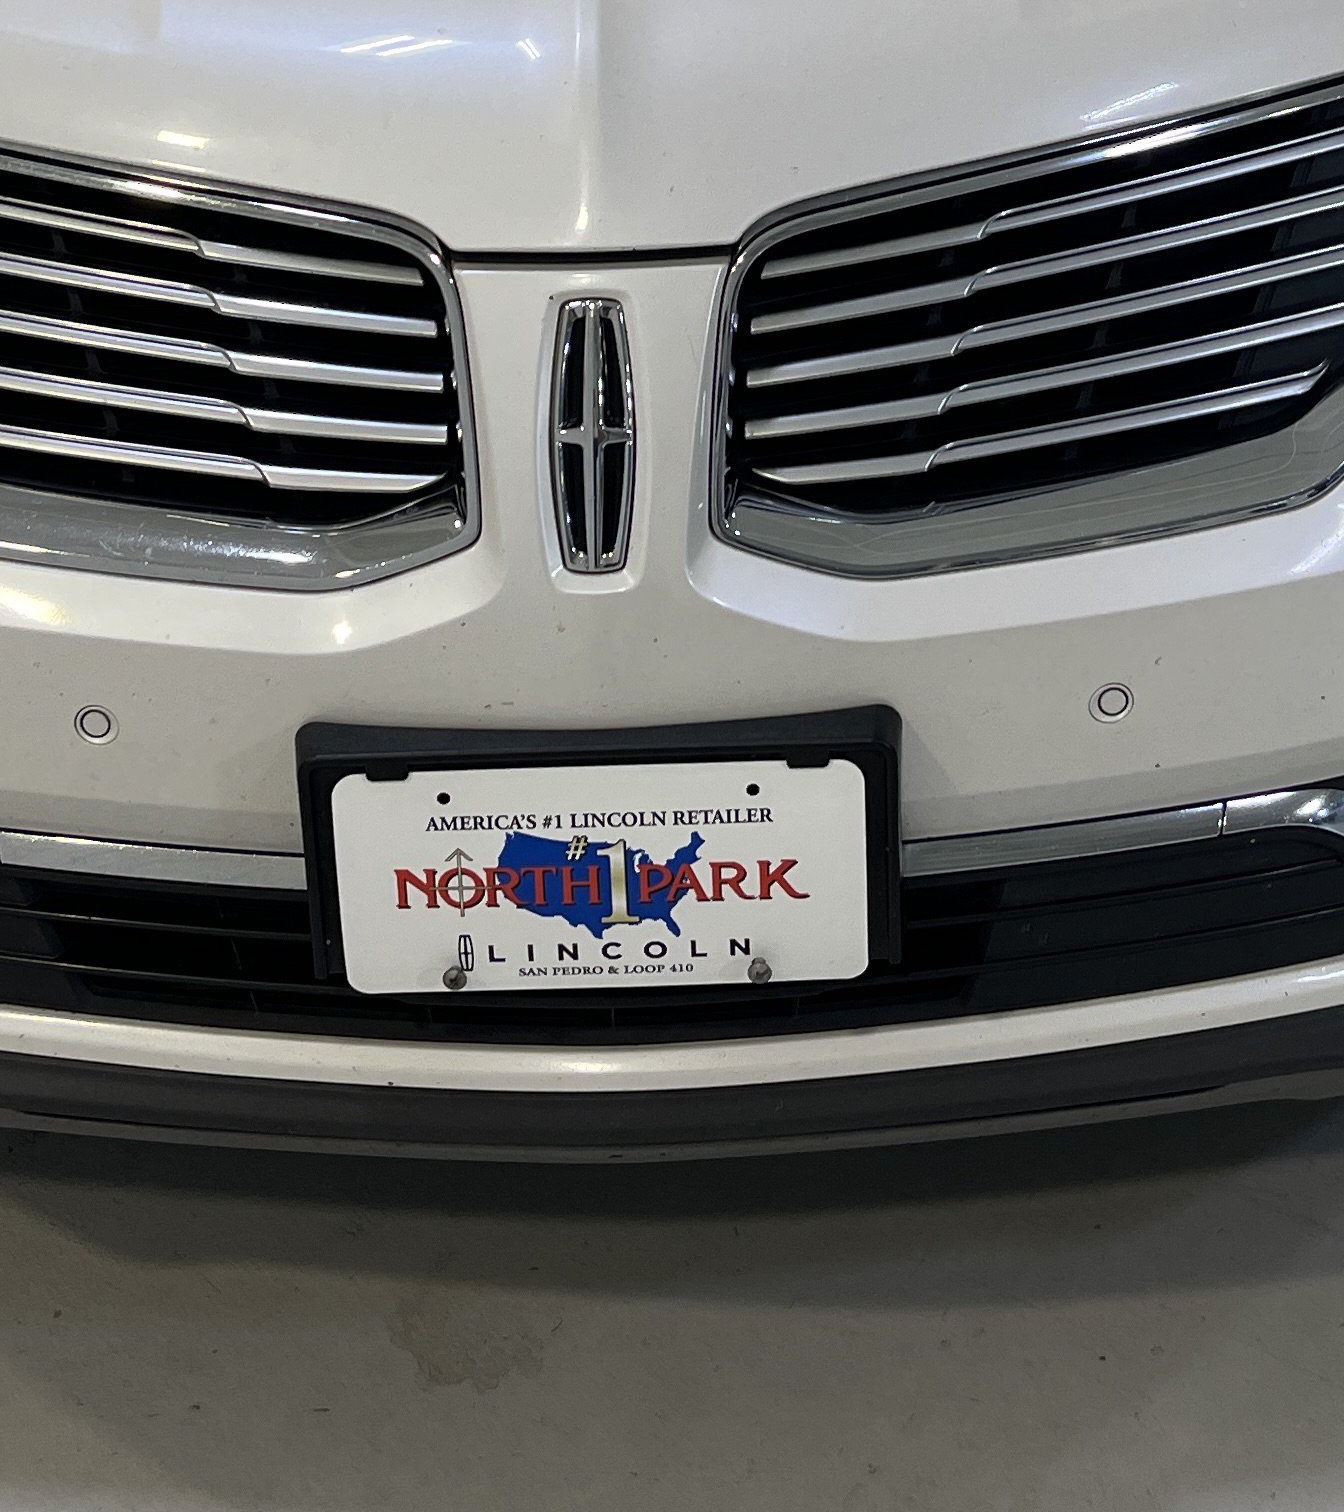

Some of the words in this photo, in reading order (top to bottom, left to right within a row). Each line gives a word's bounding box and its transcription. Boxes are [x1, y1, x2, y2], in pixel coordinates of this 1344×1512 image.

[542, 814, 562, 830] #1
[570, 810, 667, 829] LINCOLN
[672, 806, 774, 826] RETAILER
[393, 863, 603, 910] NORTH
[635, 858, 811, 903] PARK
[487, 937, 752, 963] LINCOLN
[518, 966, 548, 977] SAN
[552, 965, 604, 976] PEDRO
[607, 964, 620, 975] &
[623, 963, 666, 975] LOOP
[669, 962, 695, 973] 410
